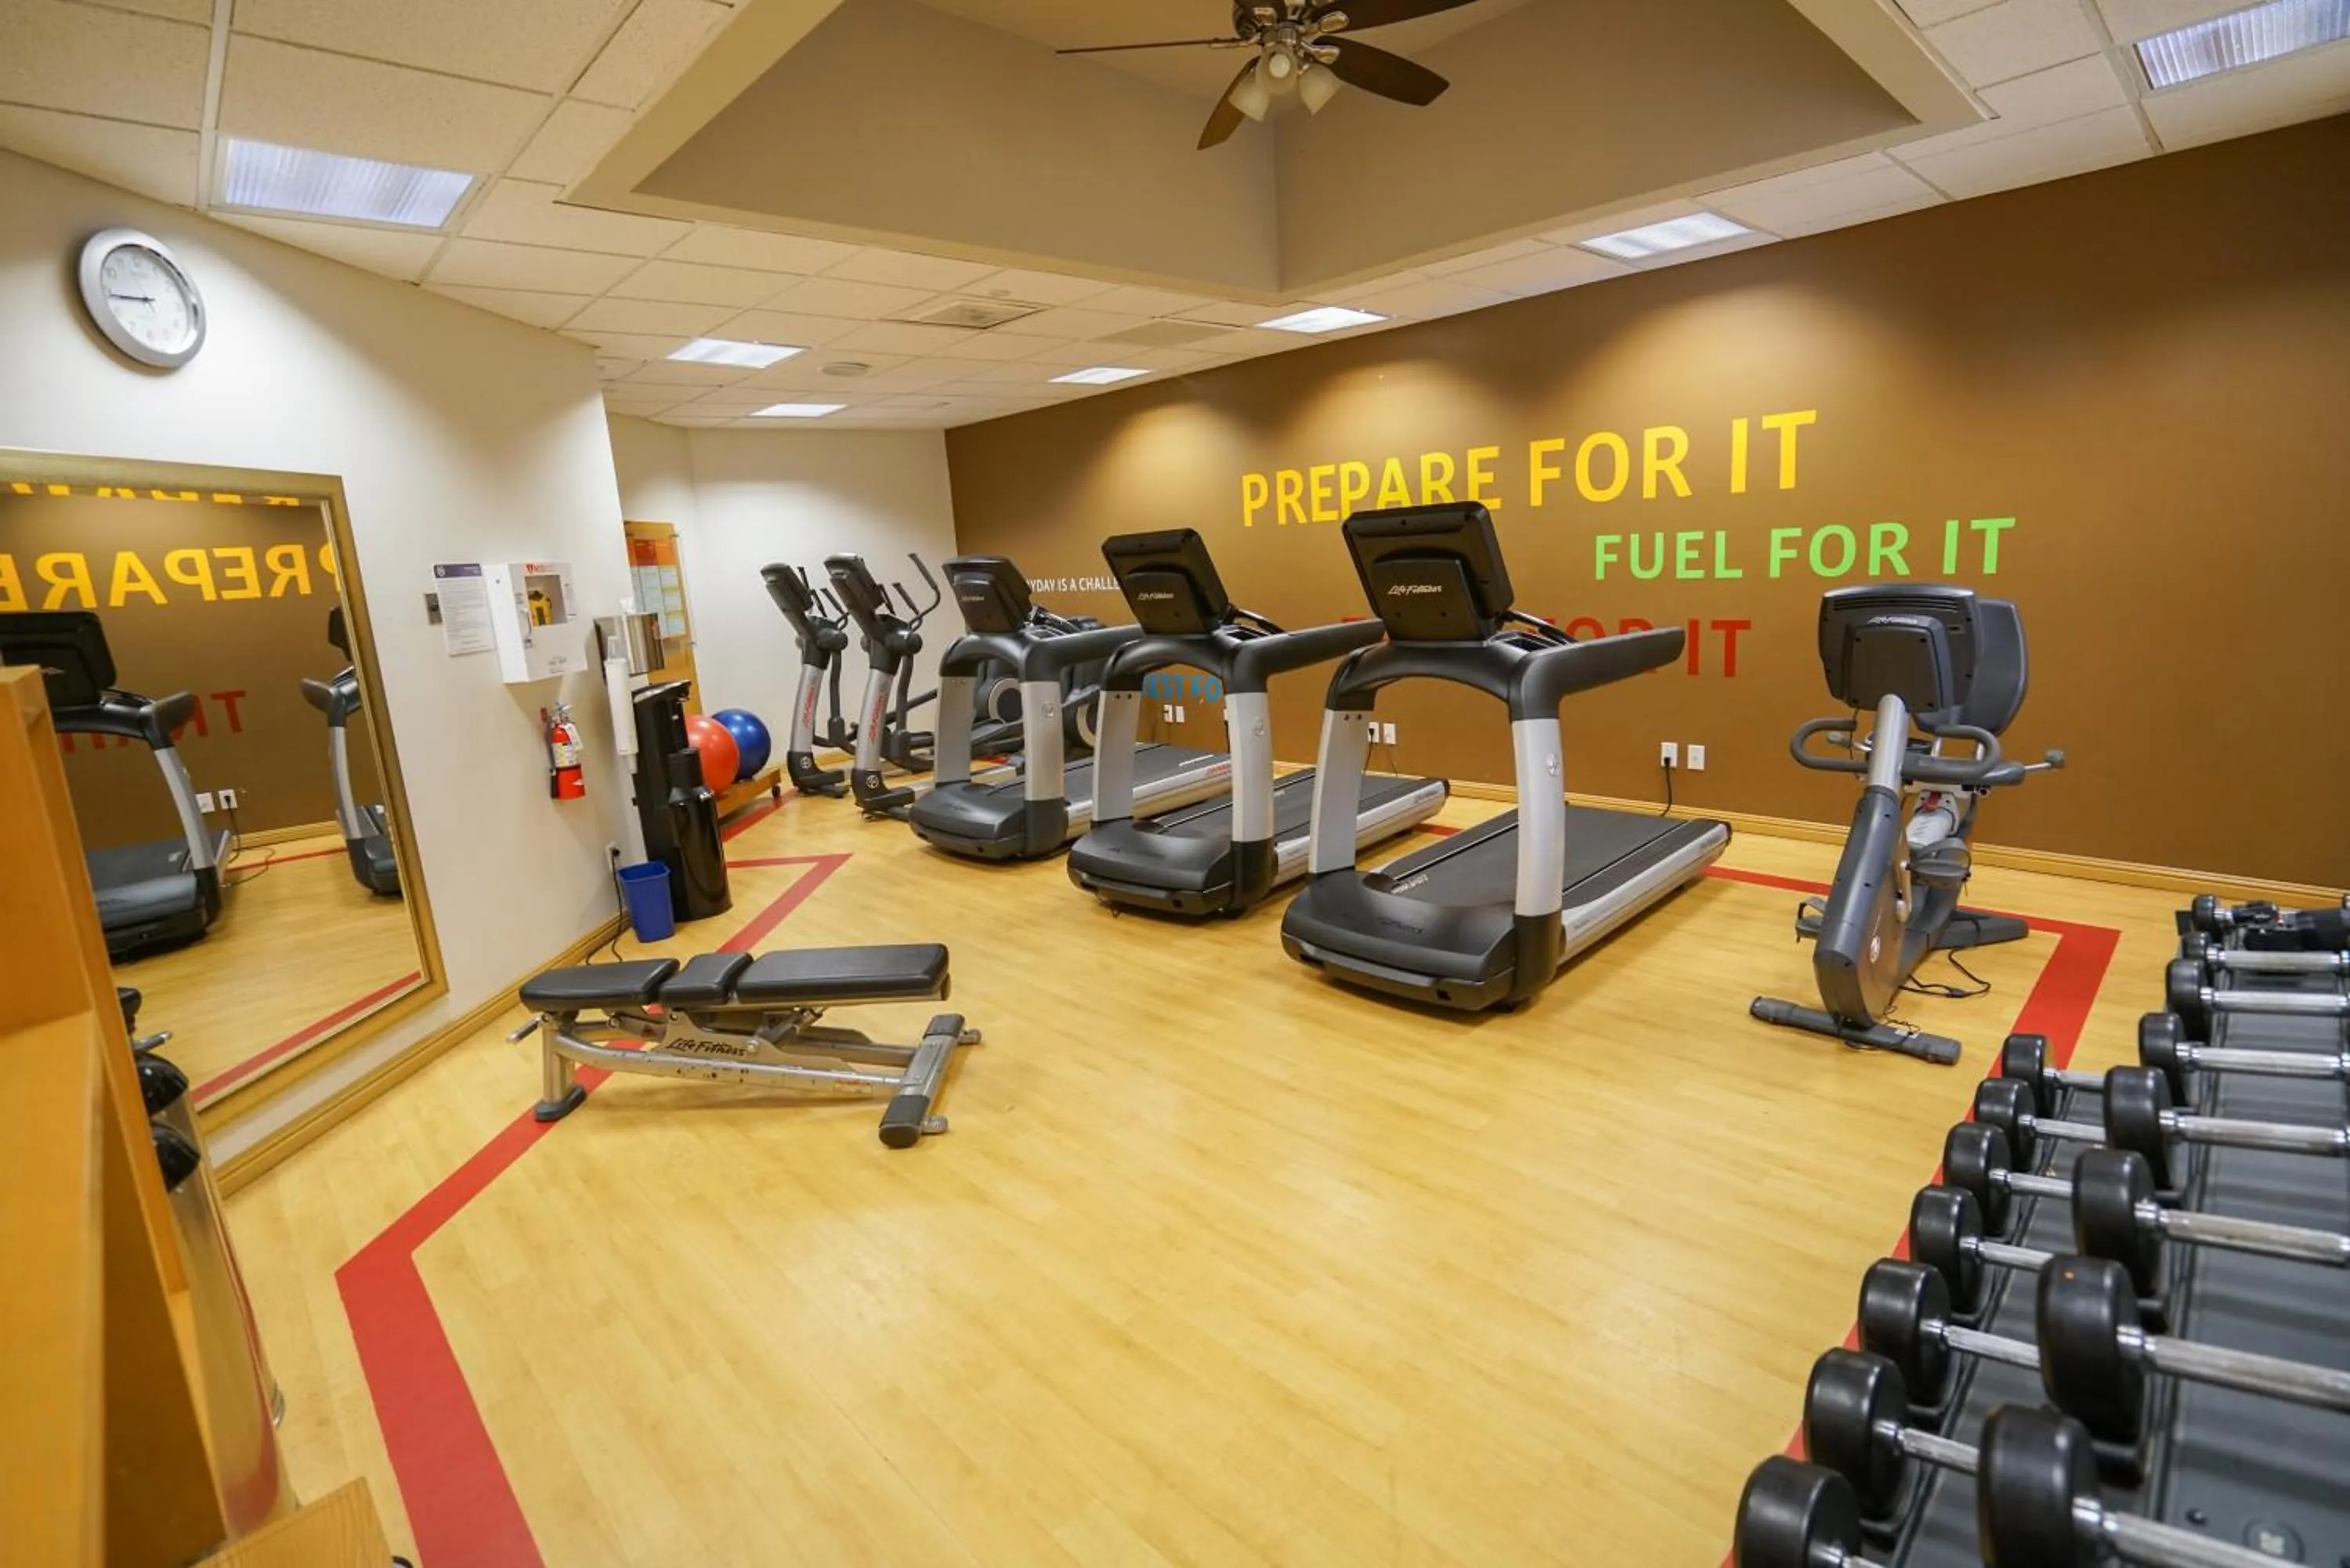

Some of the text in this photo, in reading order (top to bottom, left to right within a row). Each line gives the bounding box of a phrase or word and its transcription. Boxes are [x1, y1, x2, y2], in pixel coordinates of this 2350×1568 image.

[1242, 409, 1817, 527] PREPARE FOR IT
[1595, 518, 2016, 580] FUEL FOR IT
[1026, 576, 1120, 592] YDAY IS A CHALLE
[1687, 618, 1752, 677] IT
[1143, 674, 1222, 703] EST FO
[664, 1038, 747, 1057] Life Fitness
